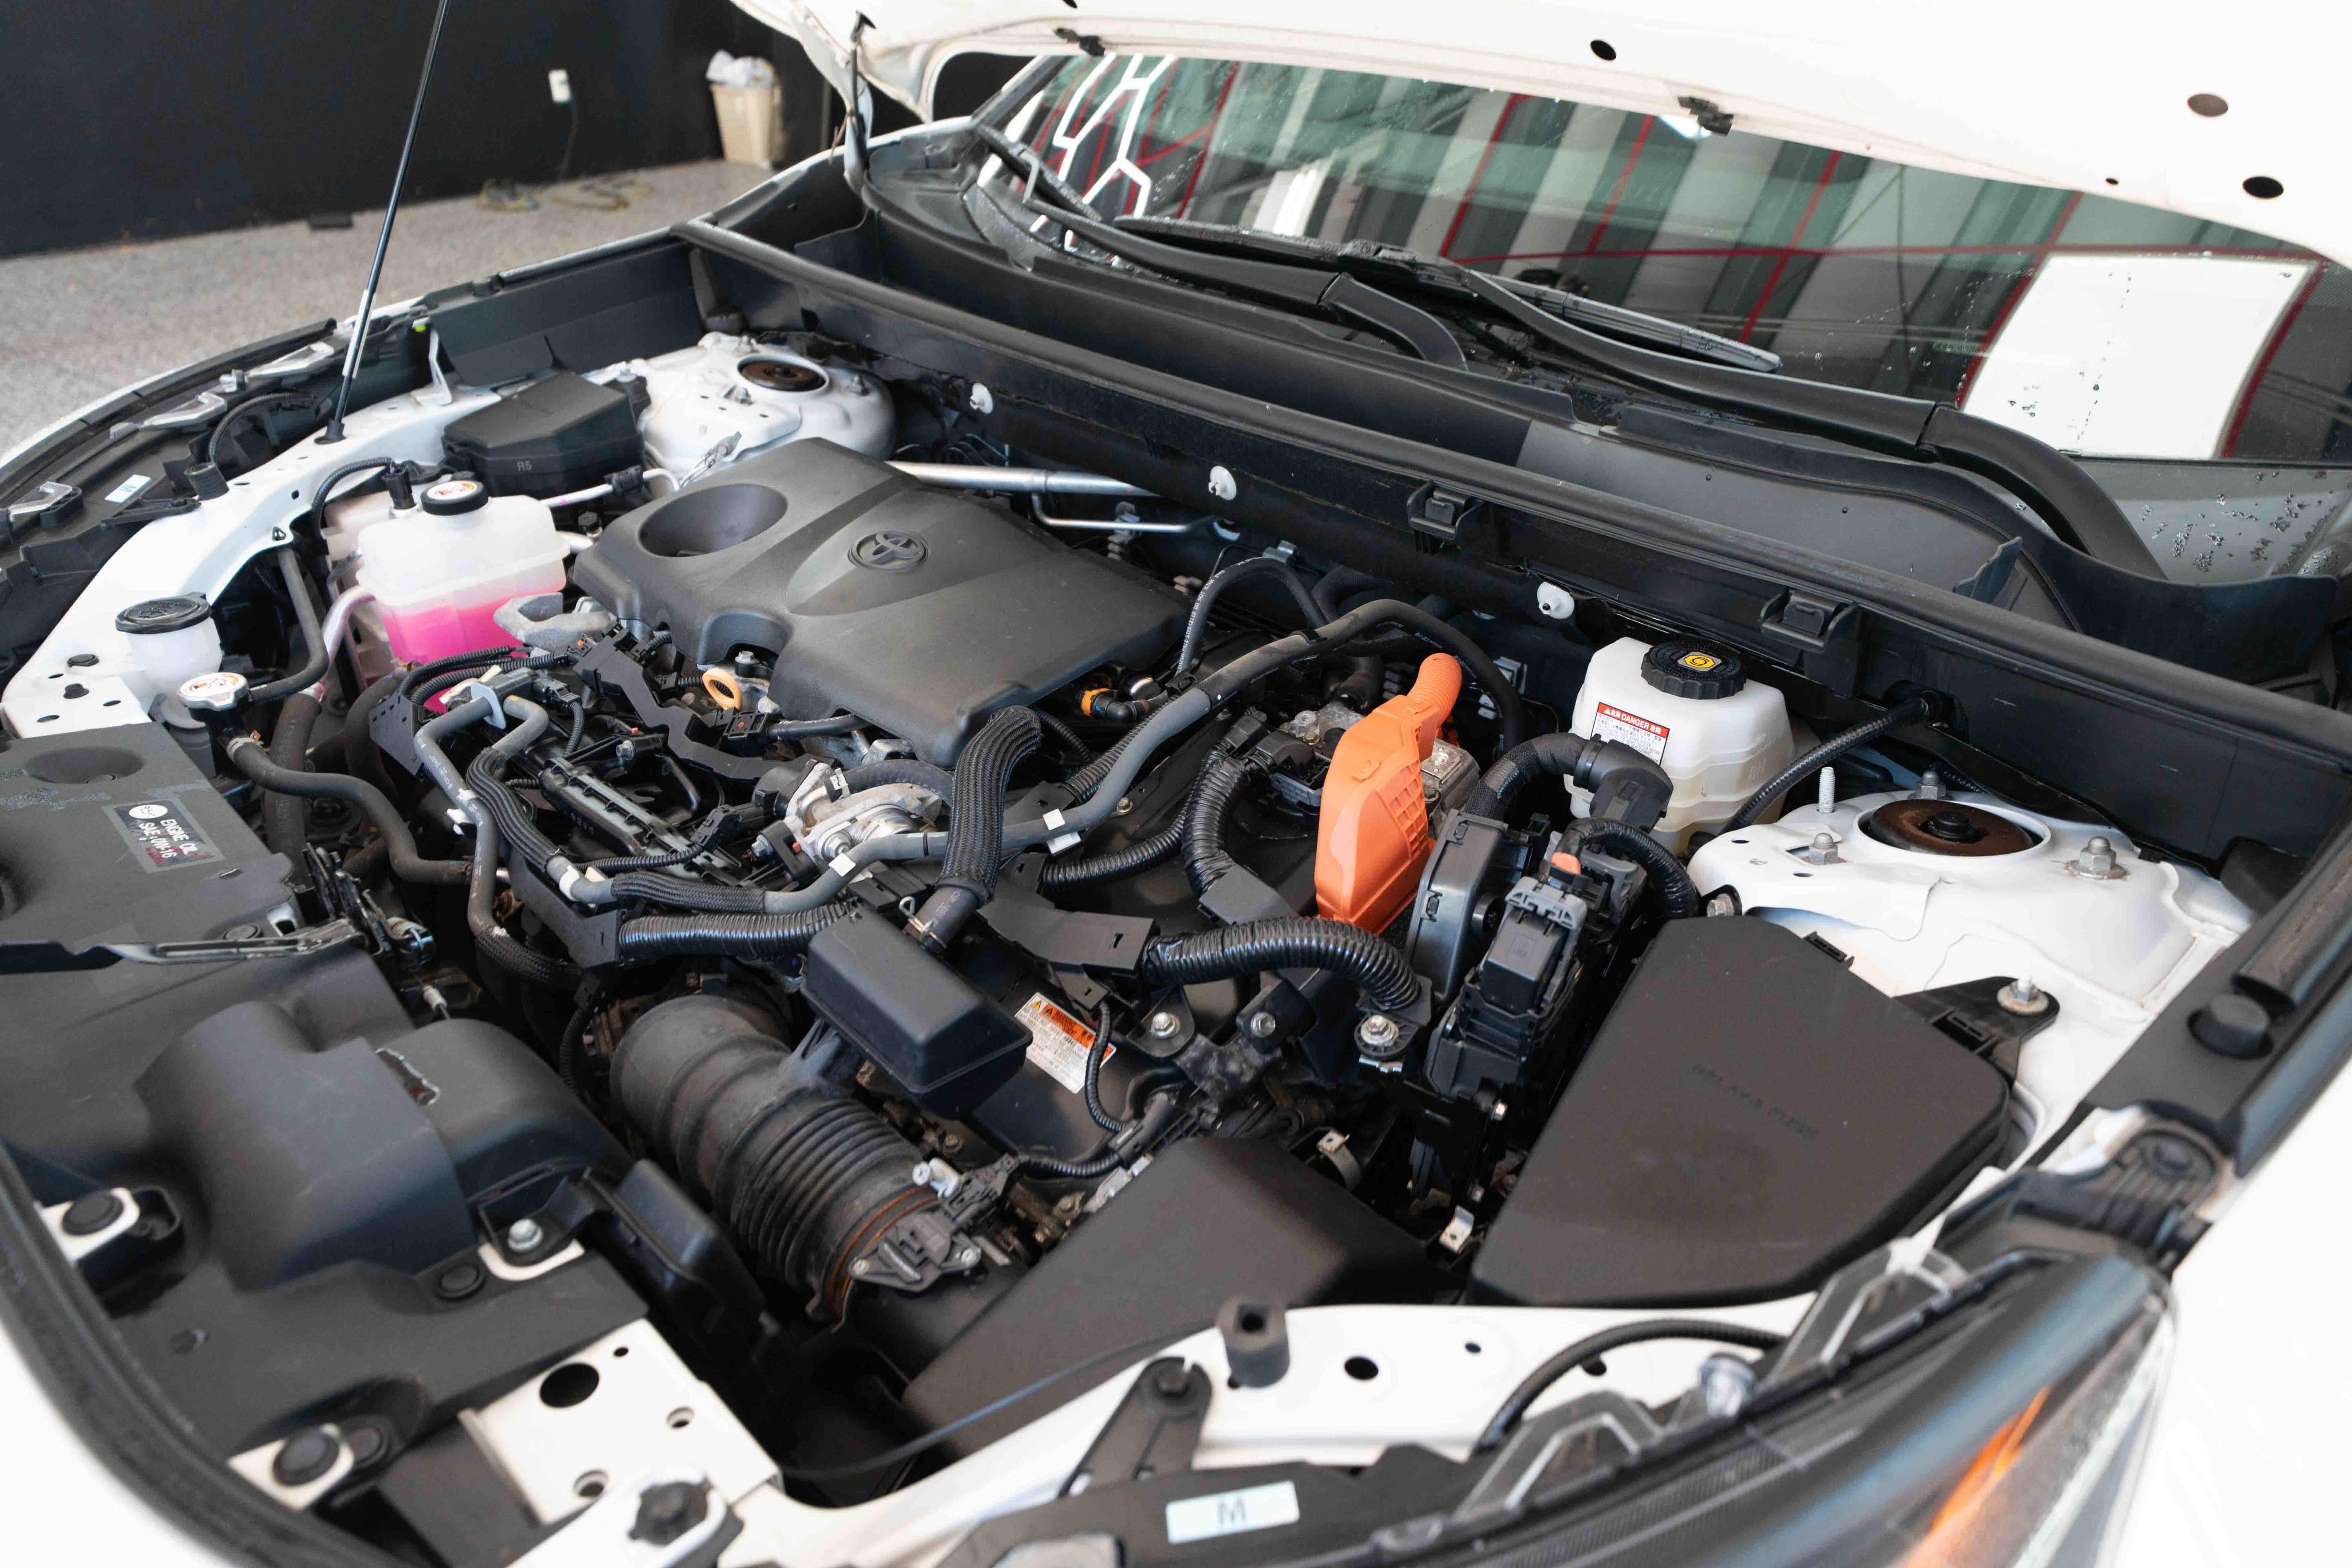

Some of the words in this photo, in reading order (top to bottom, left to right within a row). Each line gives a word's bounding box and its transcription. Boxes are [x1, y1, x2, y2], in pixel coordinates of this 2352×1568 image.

[1621, 713, 1650, 730] DANGER
[160, 819, 189, 842] ENGINE
[179, 843, 198, 855] OIL
[1216, 1498, 1246, 1524] M
